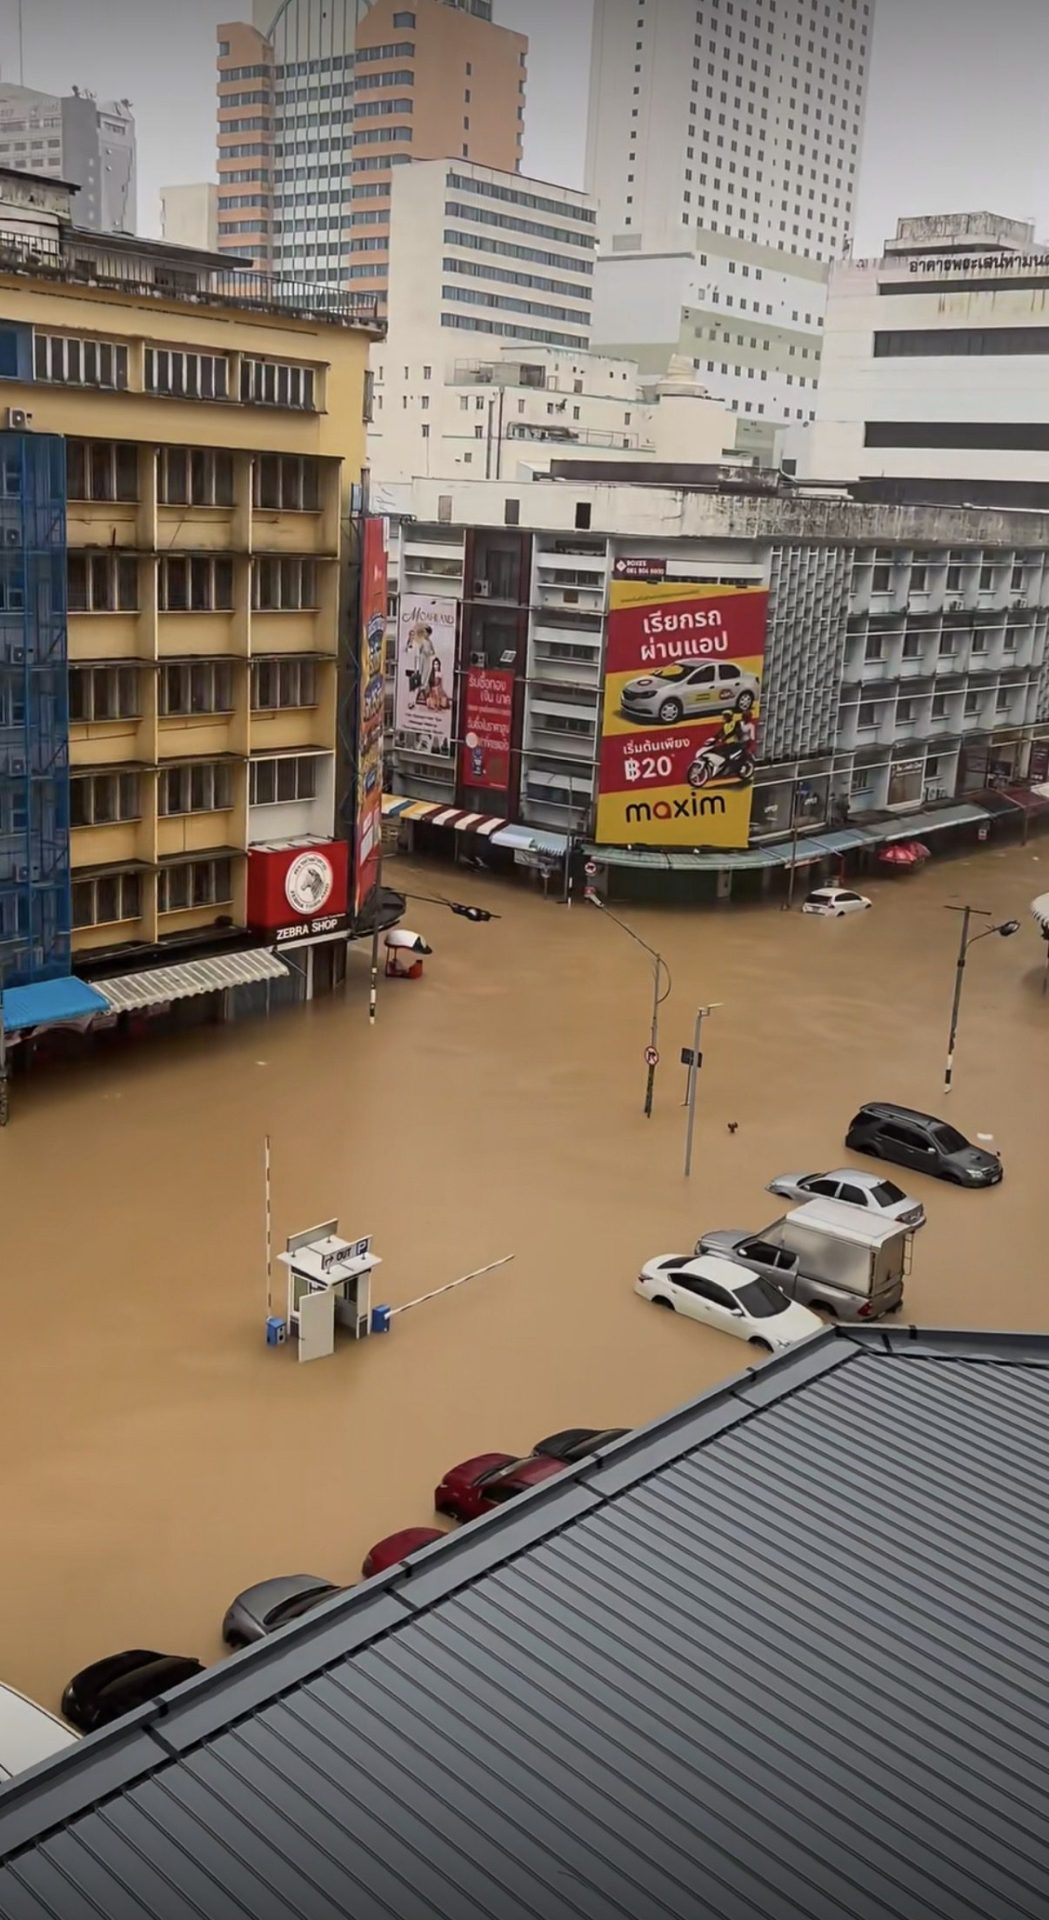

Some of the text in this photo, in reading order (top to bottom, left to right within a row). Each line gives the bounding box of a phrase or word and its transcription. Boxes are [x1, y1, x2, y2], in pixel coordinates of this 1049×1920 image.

[643, 609, 722, 634] เรียกรถ
[640, 630, 729, 661] ผ่านแอป
[623, 737, 690, 755] เริ่มต้นเพียง
[626, 791, 726, 823] maxim
[276, 918, 339, 941] ZEBRA SHOP
[336, 1240, 367, 1262] OUT P
